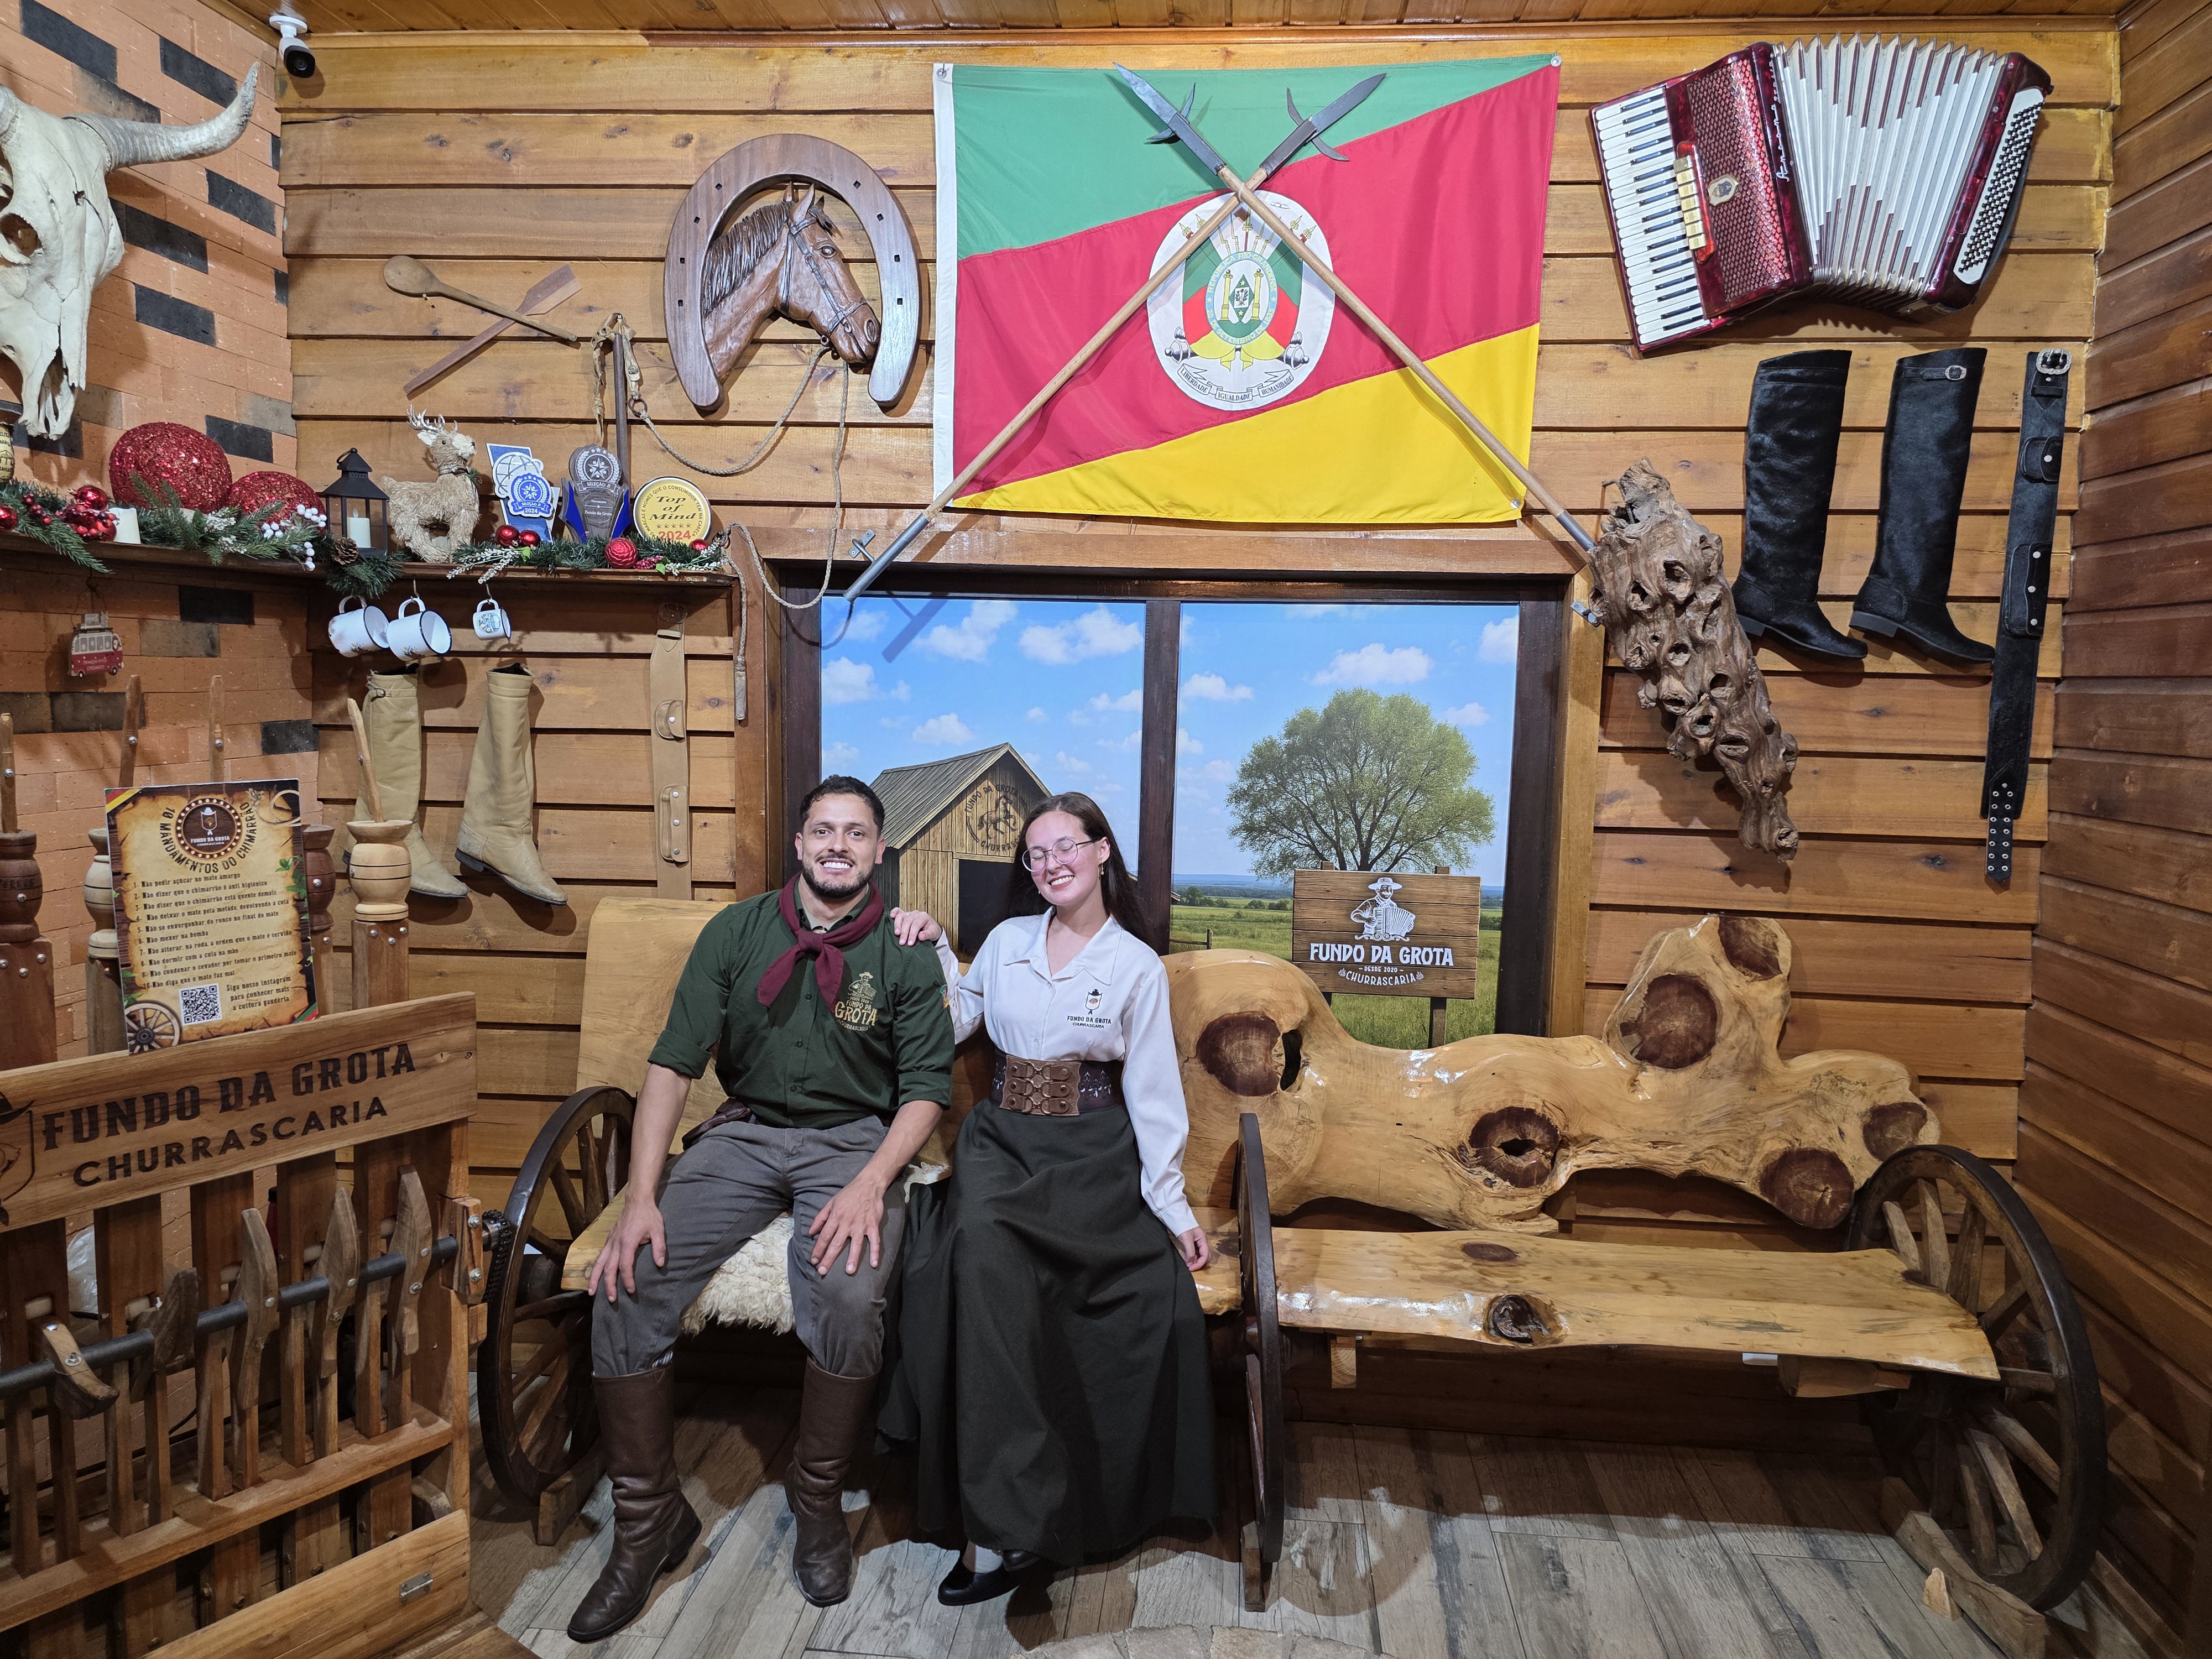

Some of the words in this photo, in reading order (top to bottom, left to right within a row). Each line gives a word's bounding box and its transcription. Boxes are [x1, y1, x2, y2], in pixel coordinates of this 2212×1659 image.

[1207, 309, 1213, 318] 20
[1211, 321, 1218, 329] DE
[1217, 330, 1255, 344] SETEMBRO
[1256, 325, 1265, 334] DE
[1264, 308, 1274, 325] 1835
[1180, 368, 1208, 393] LIBERDADE
[1218, 392, 1251, 401] IGUALDADE
[1261, 375, 1292, 395] HUMANIDADE
[643, 493, 653, 508] NOMES
[668, 486, 697, 502] CONSUMIDOR
[641, 514, 650, 532] MARCAS
[692, 520, 702, 536] CABEÇA
[658, 530, 691, 540] 2024
[964, 791, 982, 813] FUNDO
[983, 786, 993, 794] DA
[996, 785, 1018, 796] GROTA
[162, 807, 175, 819] 10
[236, 802, 257, 859] CHIMARRÃO
[160, 823, 218, 874] MANDAMENTOS
[222, 857, 237, 870] DO
[240, 901, 270, 910] devolvendo
[168, 920, 205, 930] envergonhar
[1310, 943, 1365, 962] FUNDO
[1371, 946, 1392, 963] DA
[1399, 947, 1454, 966] GROTA
[164, 967, 190, 975] condenar
[258, 953, 282, 961] primeiro
[261, 977, 291, 986] instagram
[1346, 971, 1416, 986] CHURRASCARIA
[247, 990, 274, 998] conhecer
[835, 1001, 878, 1026] GROTA
[43, 1086, 200, 1151] FUNDO
[217, 1071, 276, 1114] DA
[292, 1043, 416, 1096] GROTA
[73, 1097, 388, 1187] CHURRASCARIA
